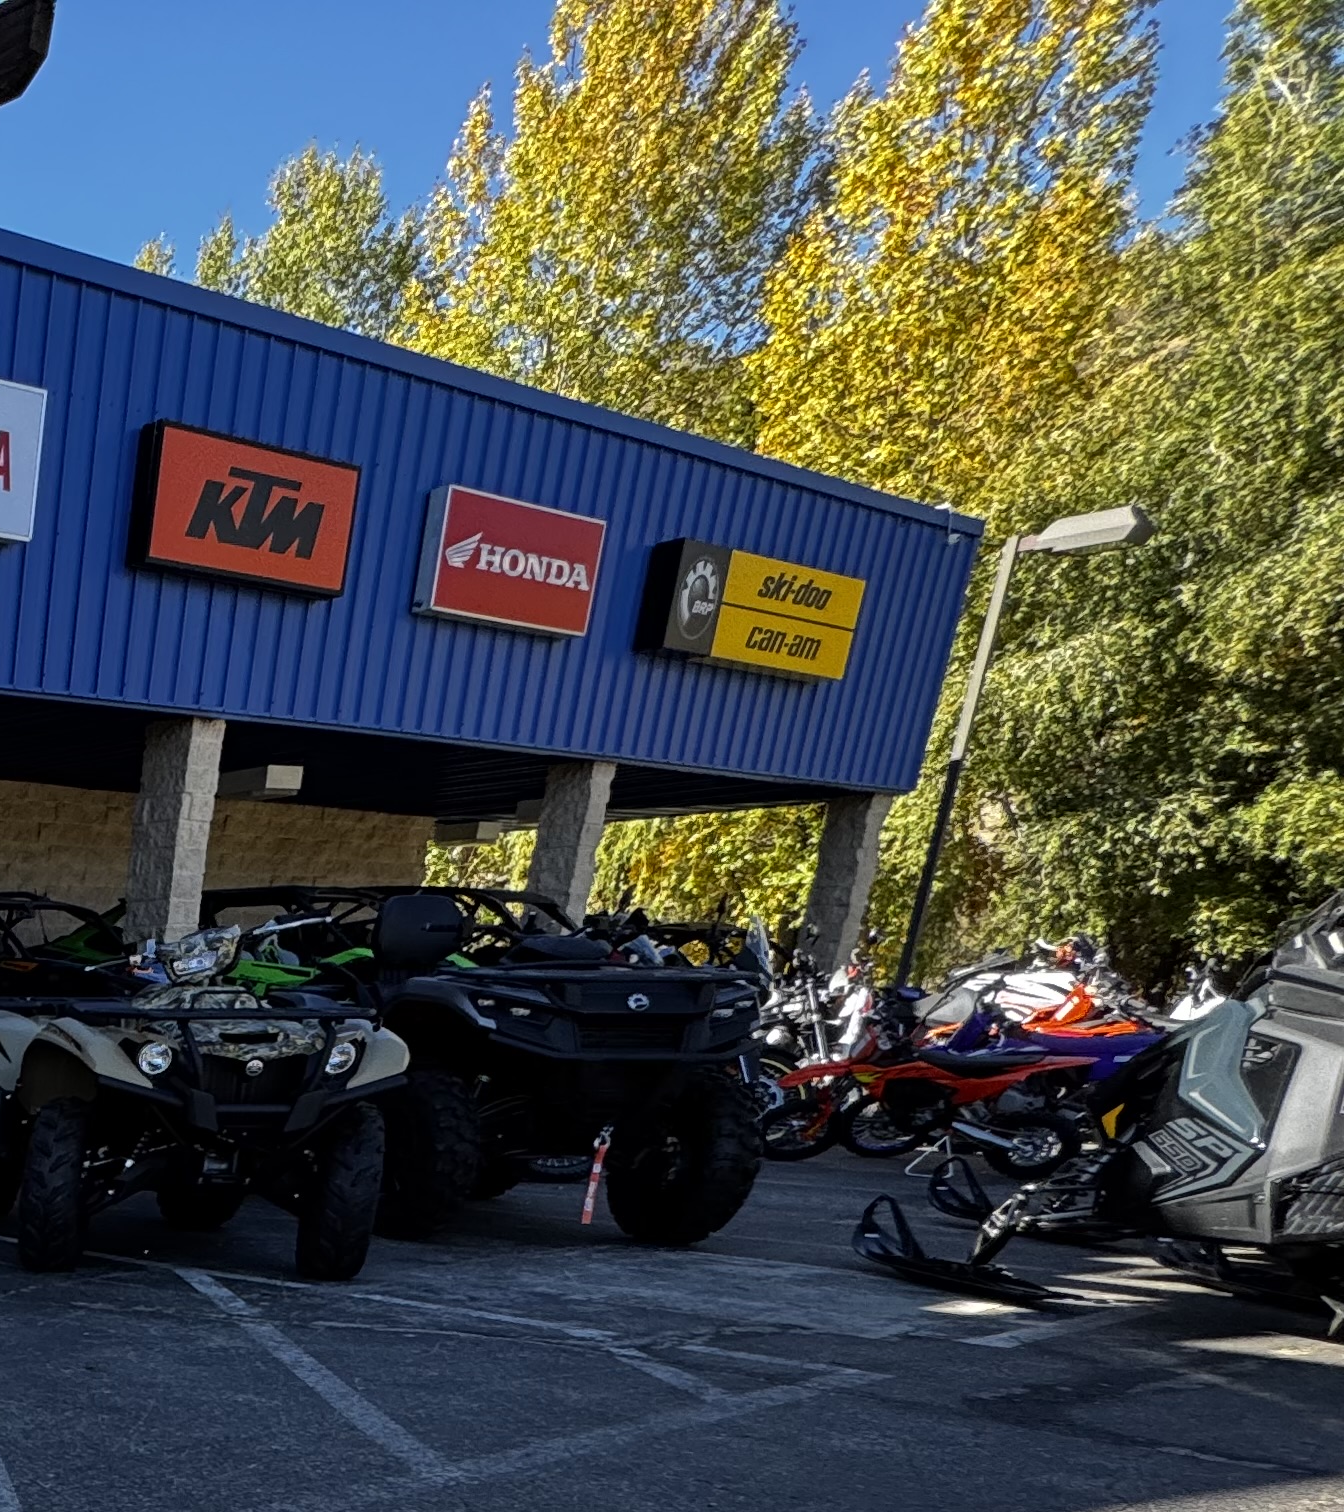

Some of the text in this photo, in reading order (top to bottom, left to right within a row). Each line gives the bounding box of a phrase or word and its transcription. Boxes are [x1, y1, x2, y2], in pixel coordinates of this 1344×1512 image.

[185, 466, 325, 560] KTM
[476, 543, 590, 592] HONDA
[691, 599, 715, 616] BRP
[757, 572, 832, 611] ski-doo
[745, 626, 822, 661] can-am
[1150, 1130, 1201, 1171] 650
[1166, 1117, 1234, 1159] SP
